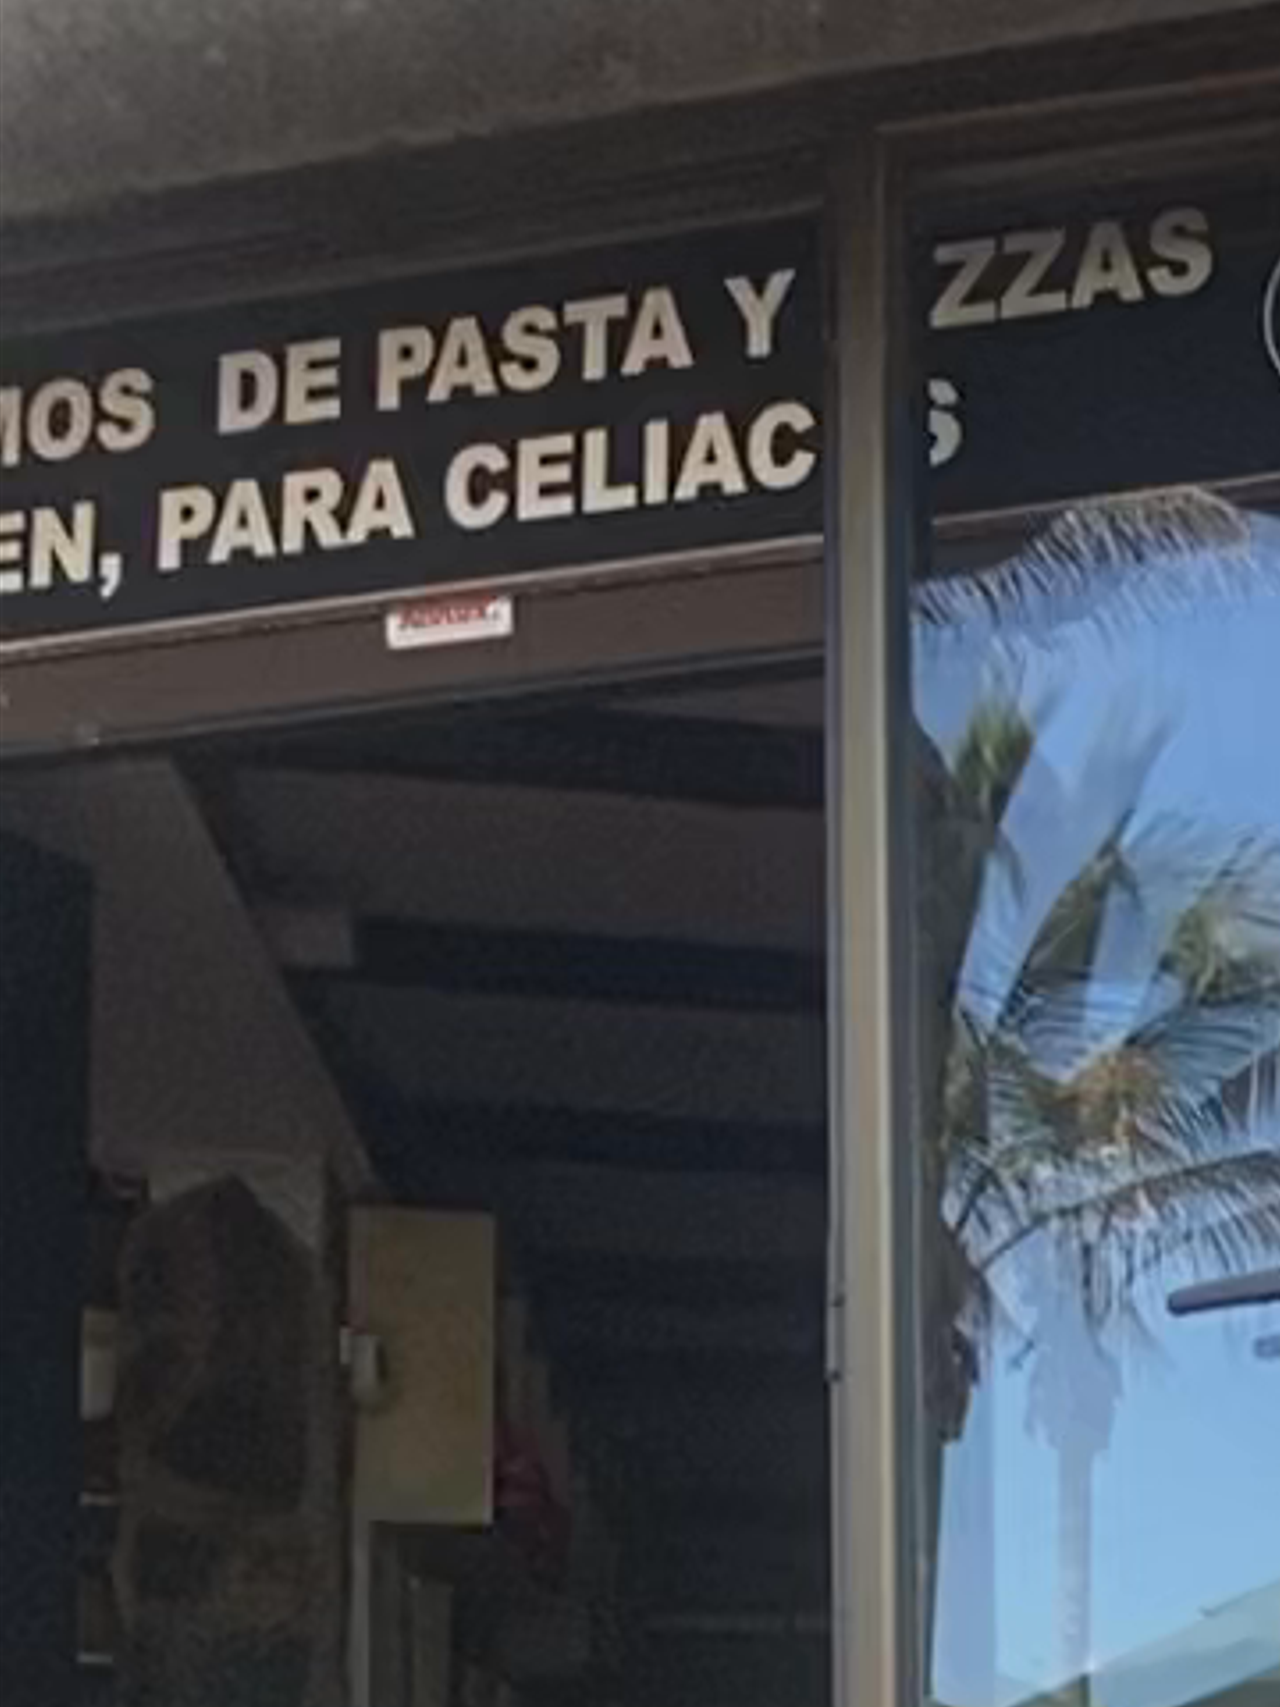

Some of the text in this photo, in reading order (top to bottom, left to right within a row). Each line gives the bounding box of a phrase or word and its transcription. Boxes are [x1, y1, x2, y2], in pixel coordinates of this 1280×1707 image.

[216, 338, 342, 435] DE
[377, 290, 693, 412] PASTA
[725, 268, 796, 359] Y
[927, 204, 1215, 330] ZZAS
[156, 458, 413, 573] PARA
